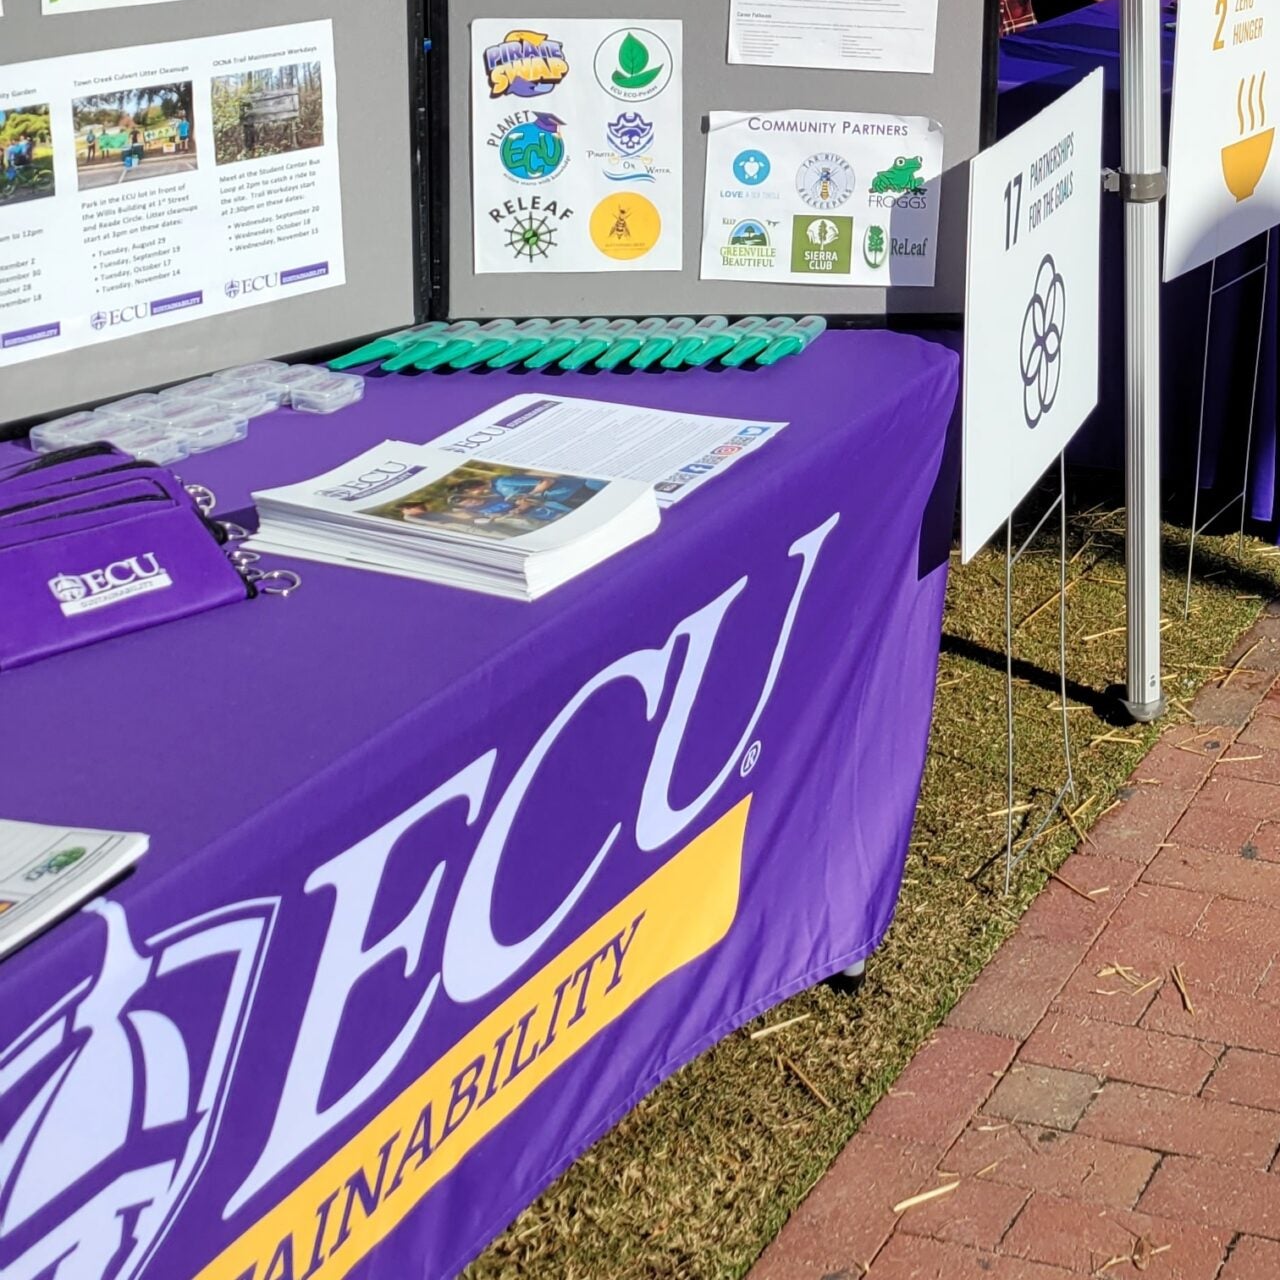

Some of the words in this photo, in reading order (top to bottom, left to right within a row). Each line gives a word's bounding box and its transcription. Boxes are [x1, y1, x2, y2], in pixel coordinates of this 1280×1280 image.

[1233, 17, 1263, 46] HUNGER
[486, 40, 564, 70] PIRATE
[490, 57, 569, 96] SWAP
[487, 110, 531, 147] PLANET
[824, 153, 850, 170] RIVER
[1030, 131, 1074, 191] PARTNERSHIPS
[720, 190, 744, 198] LOVE
[868, 195, 927, 209] FROGGS
[1028, 198, 1041, 232] FOR
[1043, 187, 1054, 220] THE
[1055, 170, 1073, 209] GOALS
[489, 195, 574, 223] RELEAF
[1004, 171, 1022, 252] 17
[720, 246, 776, 258] GREENVILLE
[804, 250, 838, 261] SIERRA
[890, 238, 928, 257] ReLeaf
[722, 257, 774, 267] BEAUTIFUL
[809, 260, 833, 270] CLUB
[242, 272, 278, 294] ECU
[109, 302, 148, 326] ECU
[461, 426, 508, 450] ECU
[343, 461, 408, 496] ECU
[80, 552, 160, 595] ECU
[223, 511, 840, 1221] ECU
